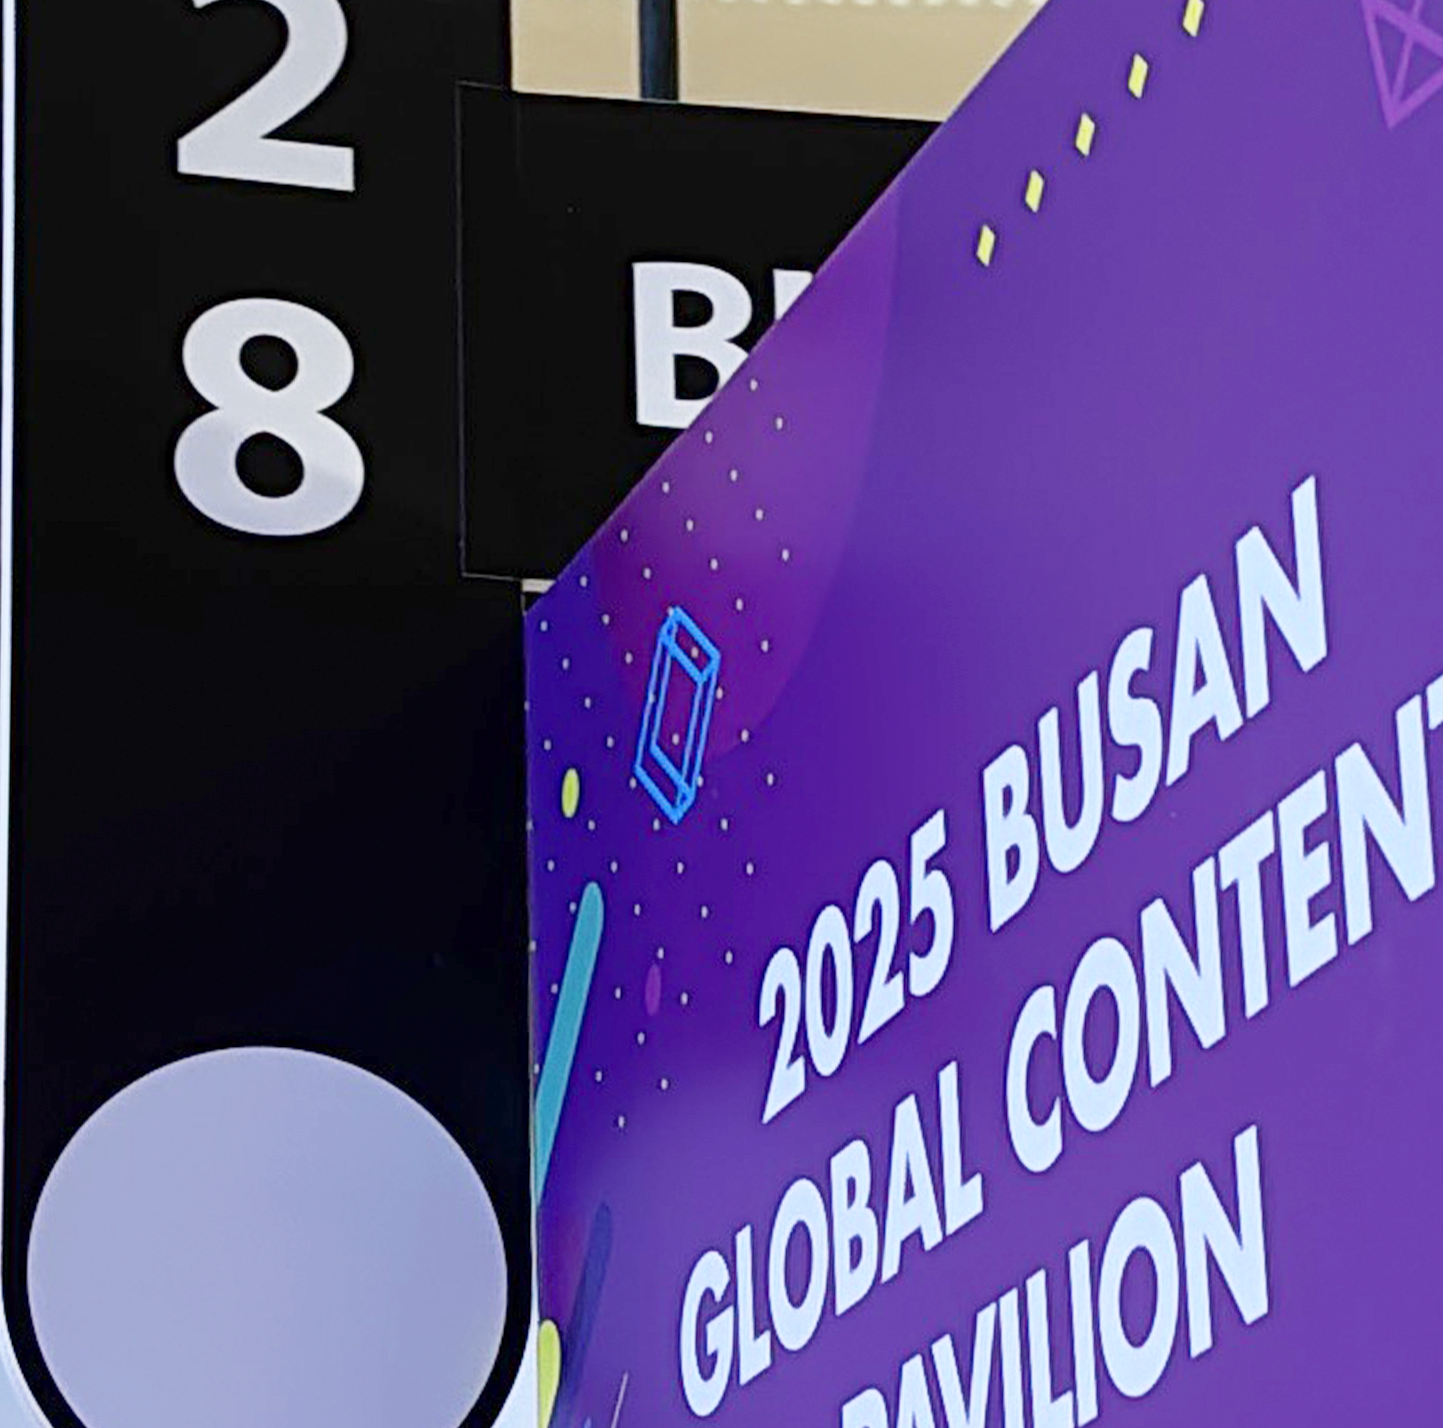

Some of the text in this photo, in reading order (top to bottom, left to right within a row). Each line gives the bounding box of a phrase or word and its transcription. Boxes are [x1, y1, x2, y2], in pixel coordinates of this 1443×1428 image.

[631, 260, 814, 430] B
[758, 474, 1328, 1125] 2025 BUSAN
[679, 1060, 984, 1418] GLOBAL
